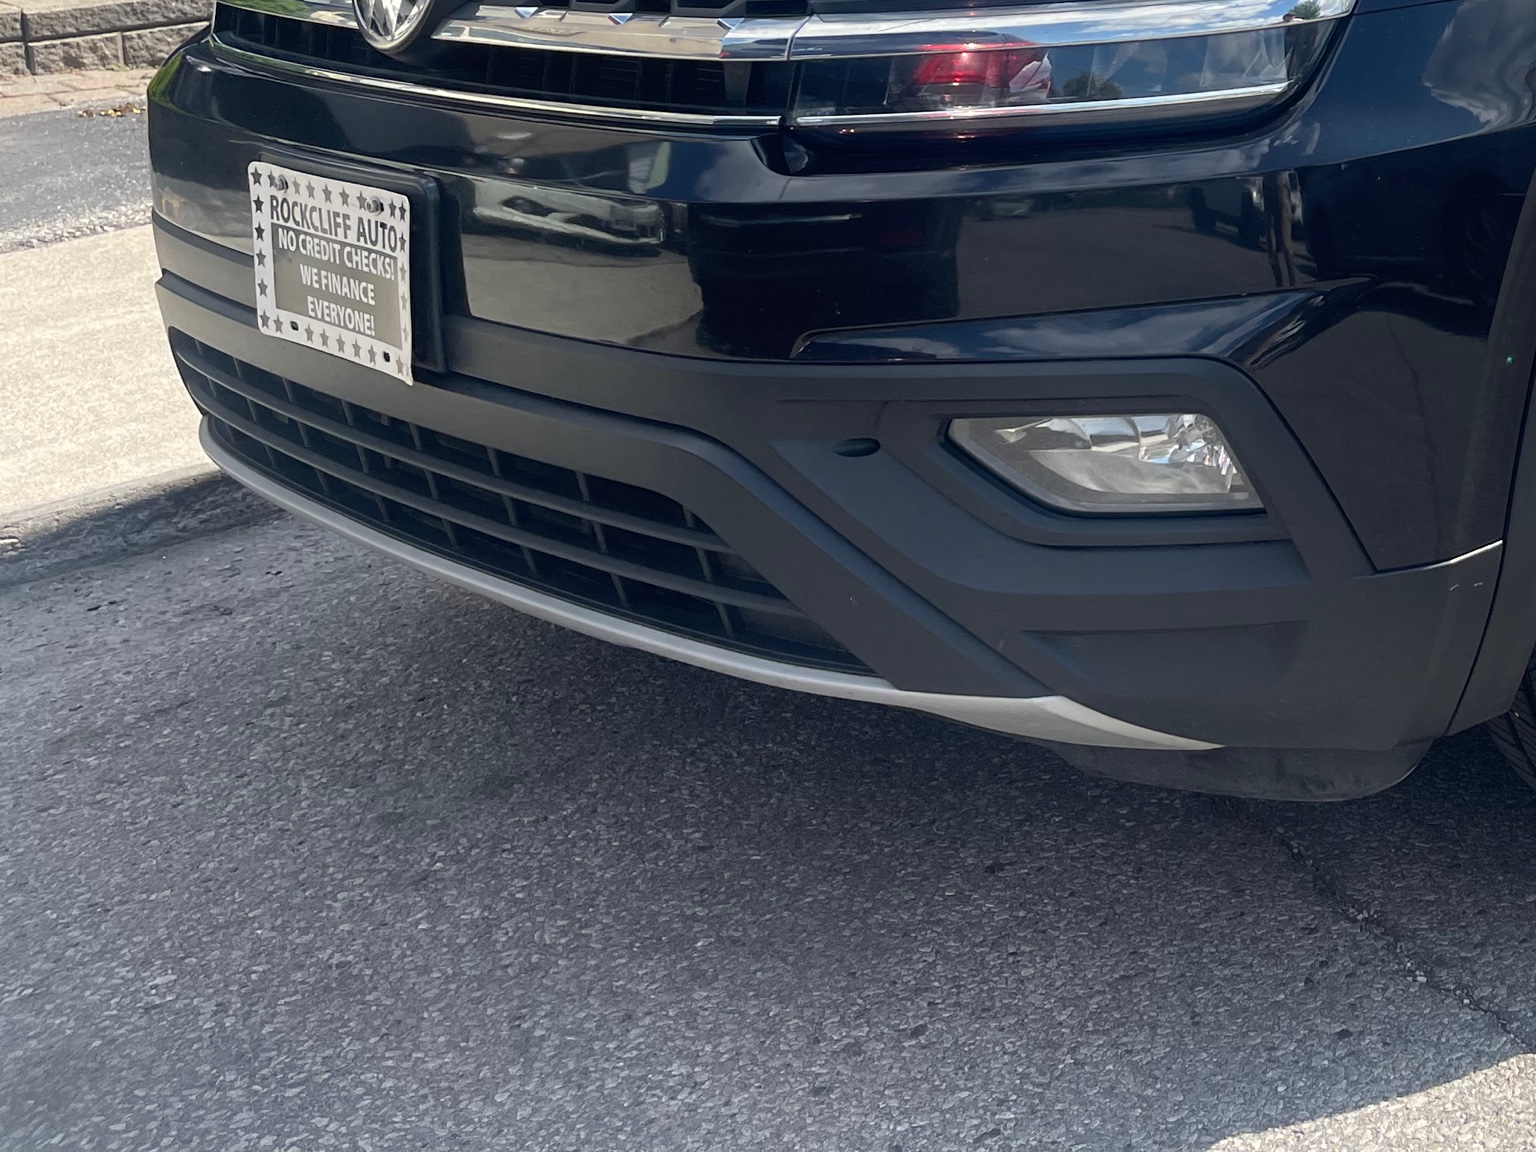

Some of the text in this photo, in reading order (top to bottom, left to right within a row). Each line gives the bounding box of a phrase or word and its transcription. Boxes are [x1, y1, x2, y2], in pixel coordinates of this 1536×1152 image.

[269, 194, 398, 254] ROCKCLIFF AUTO
[278, 227, 396, 281] NO CREDIT CHECKS!
[299, 263, 376, 306] WE FINANCE
[306, 295, 376, 337] EVERYONE!
